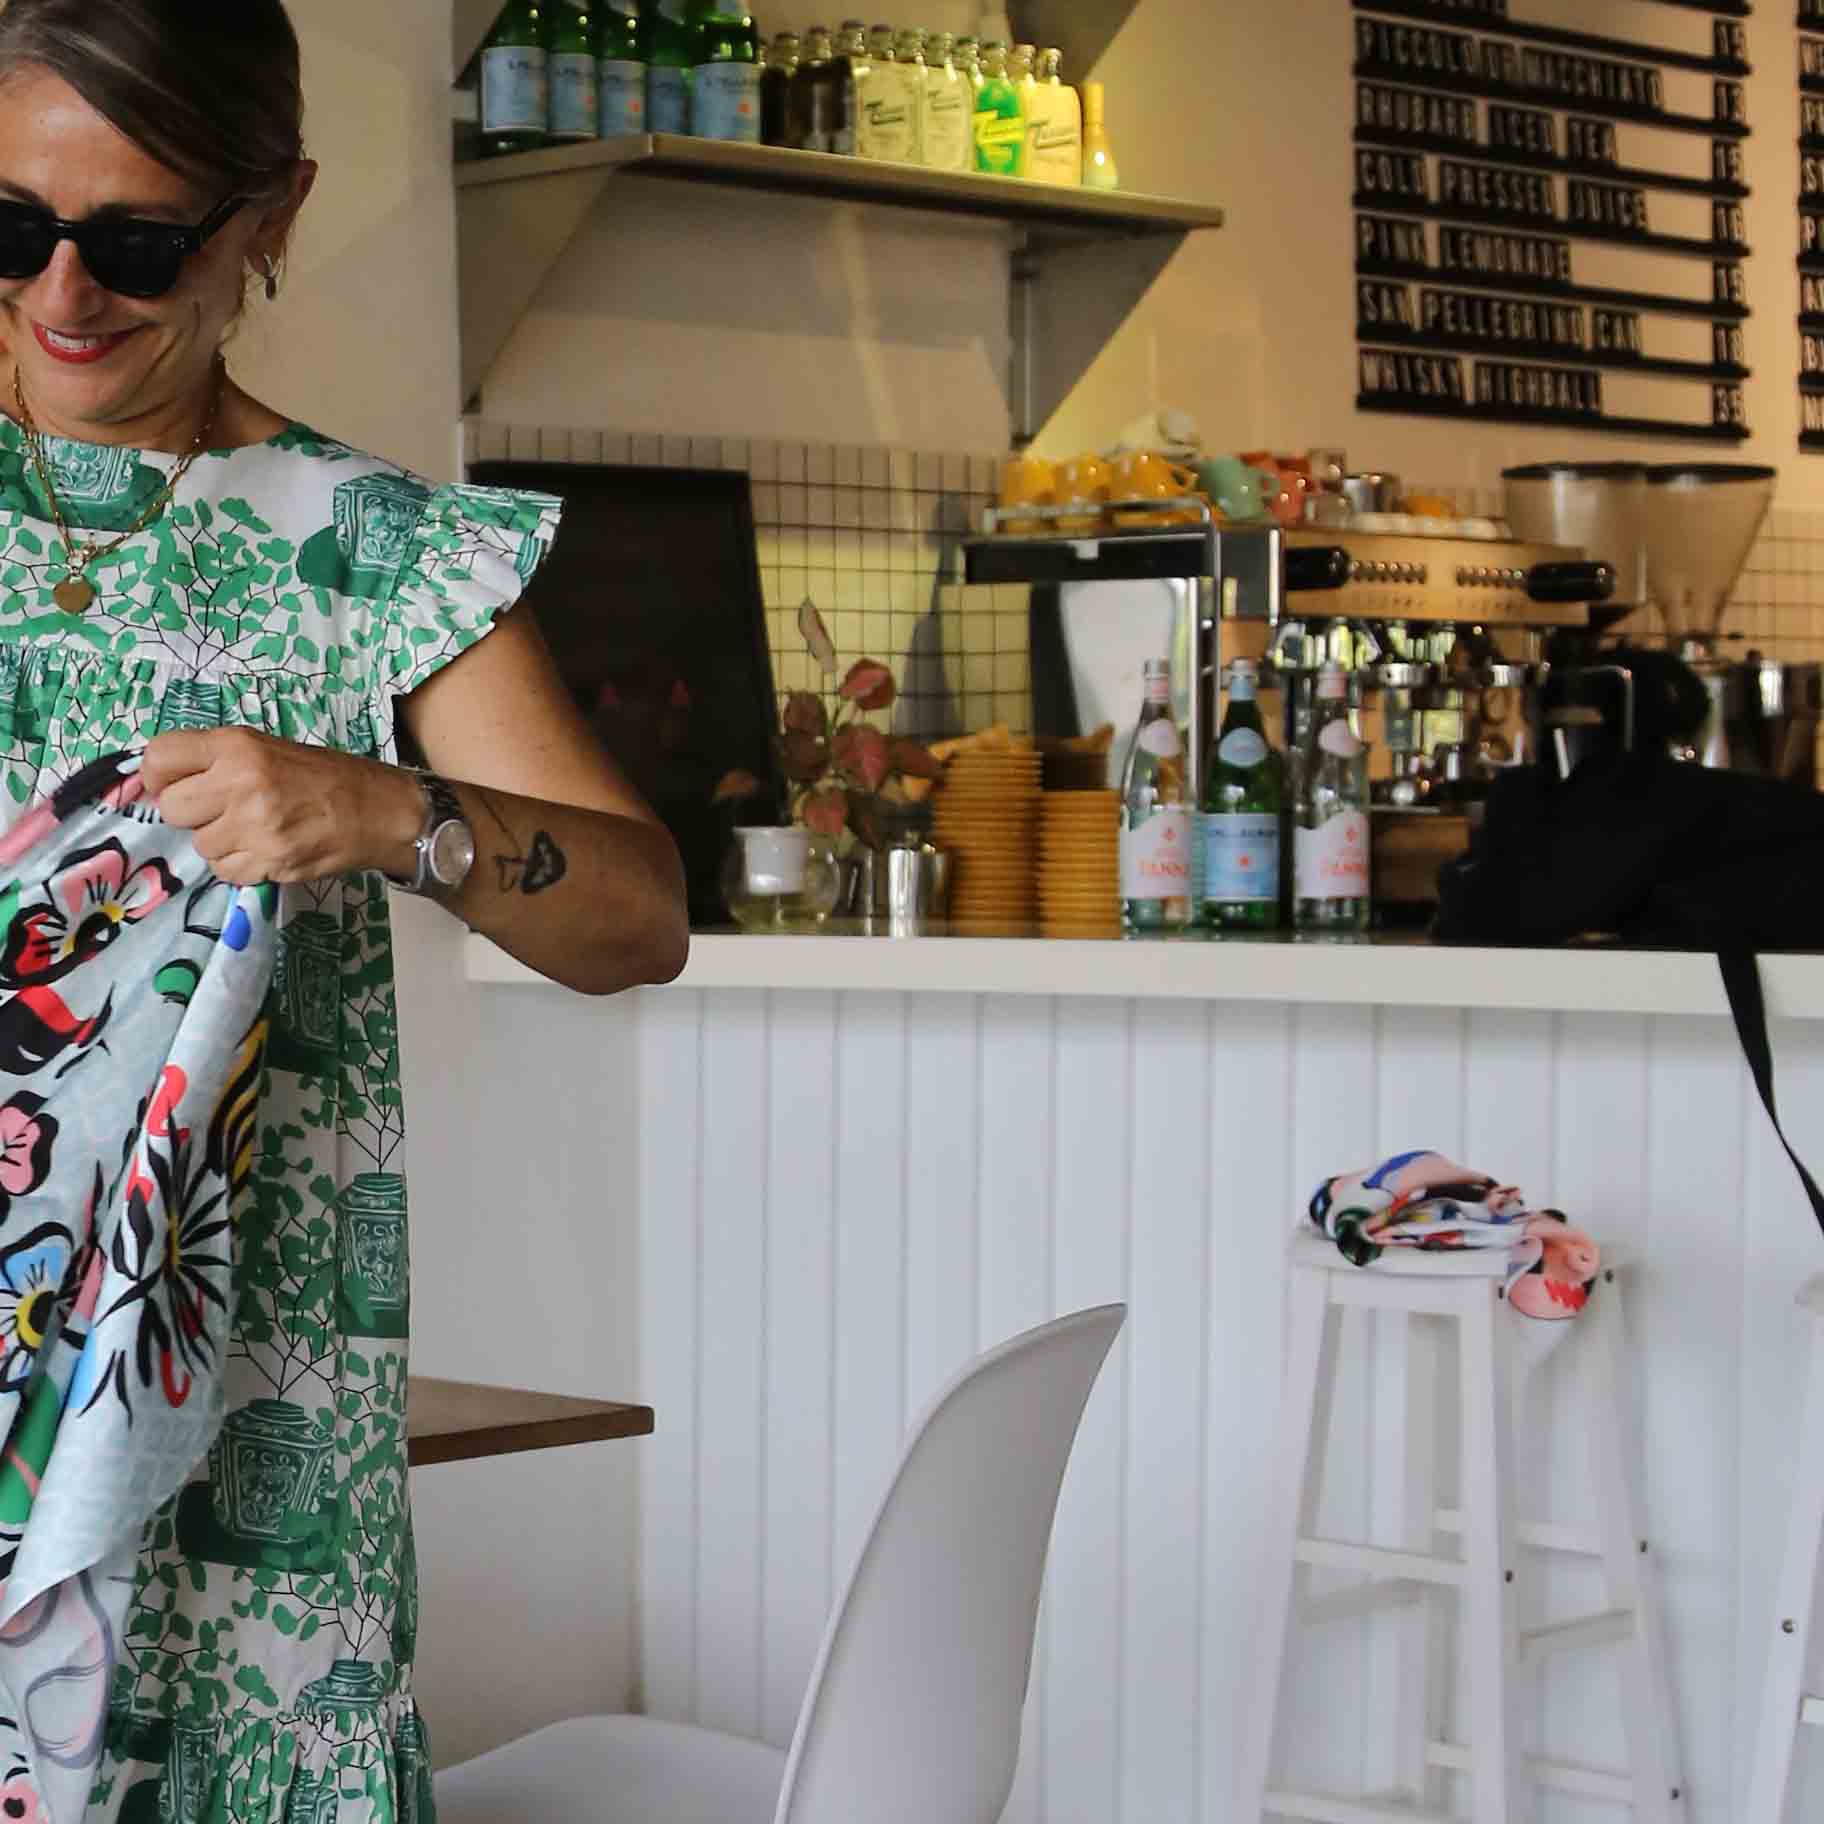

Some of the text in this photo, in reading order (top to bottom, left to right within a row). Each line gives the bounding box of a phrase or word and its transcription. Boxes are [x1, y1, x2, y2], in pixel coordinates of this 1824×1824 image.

[1360, 20, 1475, 74] PICCOLO
[1569, 121, 1616, 160] TEA
[1360, 151, 1647, 226] COLD PRESSED JUICE
[1360, 218, 1571, 279] PINK LEMONADE
[1360, 284, 1643, 350] SAN PELLEGRINO CAN
[1477, 364, 1600, 411] HIGHBALL
